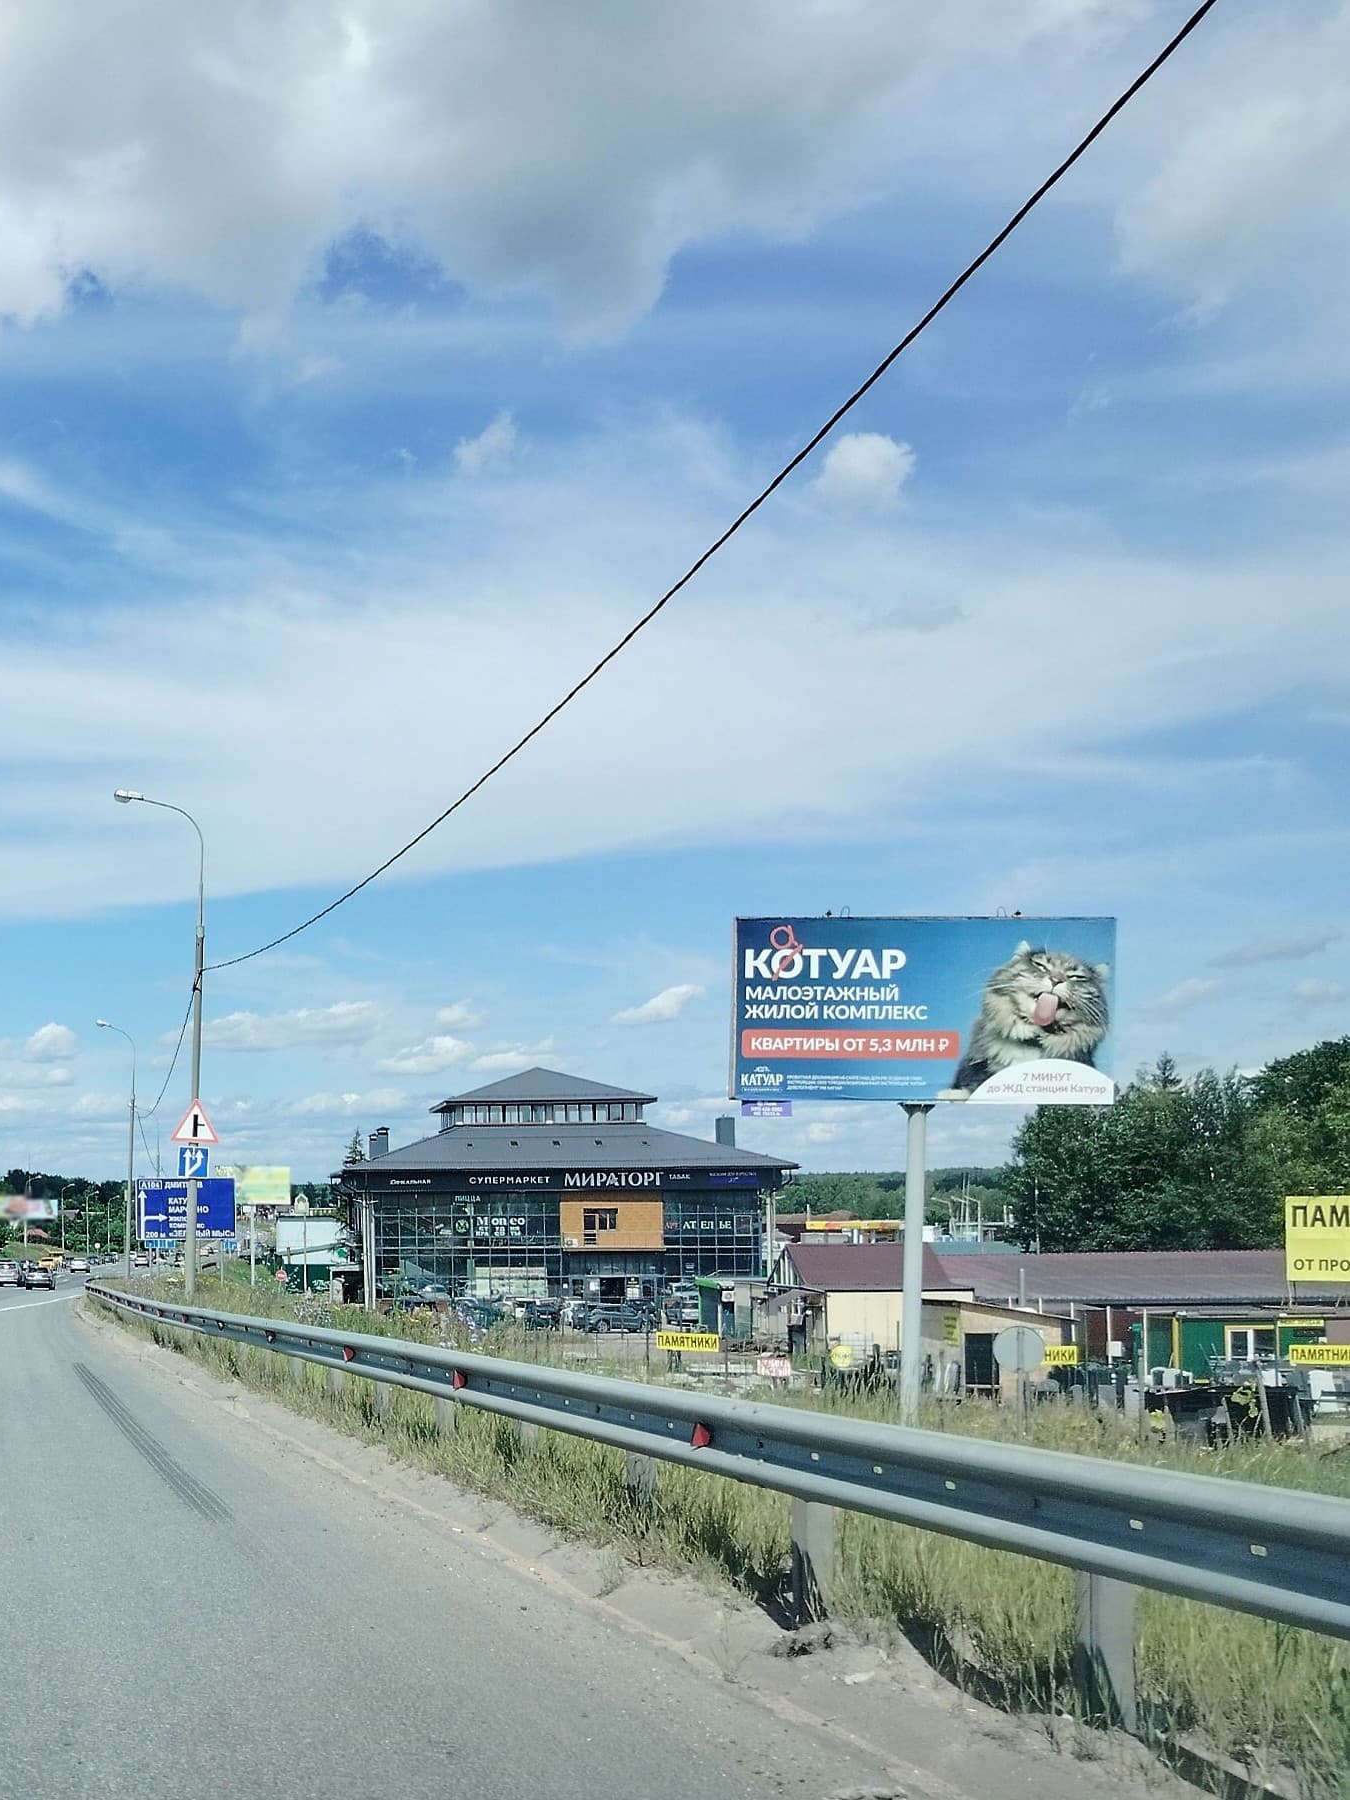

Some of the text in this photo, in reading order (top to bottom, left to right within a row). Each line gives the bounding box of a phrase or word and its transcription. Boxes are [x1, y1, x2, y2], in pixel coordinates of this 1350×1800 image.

[744, 948, 907, 980] КОТУАР
[745, 984, 899, 1001] МАЛОЭТАЖНЫЙ
[744, 1002, 928, 1020] ЖИЛОЙ КОМПЛЕКС
[751, 1037, 839, 1051] КВАРТИРЫ
[843, 1038, 866, 1052] ОТ
[869, 1039, 892, 1053] 5,3
[895, 1039, 935, 1052] МЛН
[740, 1073, 783, 1086] КАТУАР
[1022, 1073, 1071, 1081] 7 МИНУТ
[987, 1084, 1106, 1094] до ЖД станции Катуар
[164, 1181, 203, 1189] ДМИТВ
[469, 1176, 550, 1185] СУПЕРМАРКЕТ
[564, 1171, 664, 1188] МИРАТОРГ
[1294, 1259, 1350, 1271] ОТ ПРО
[657, 1335, 717, 1349] ПАМЯТНИКИ
